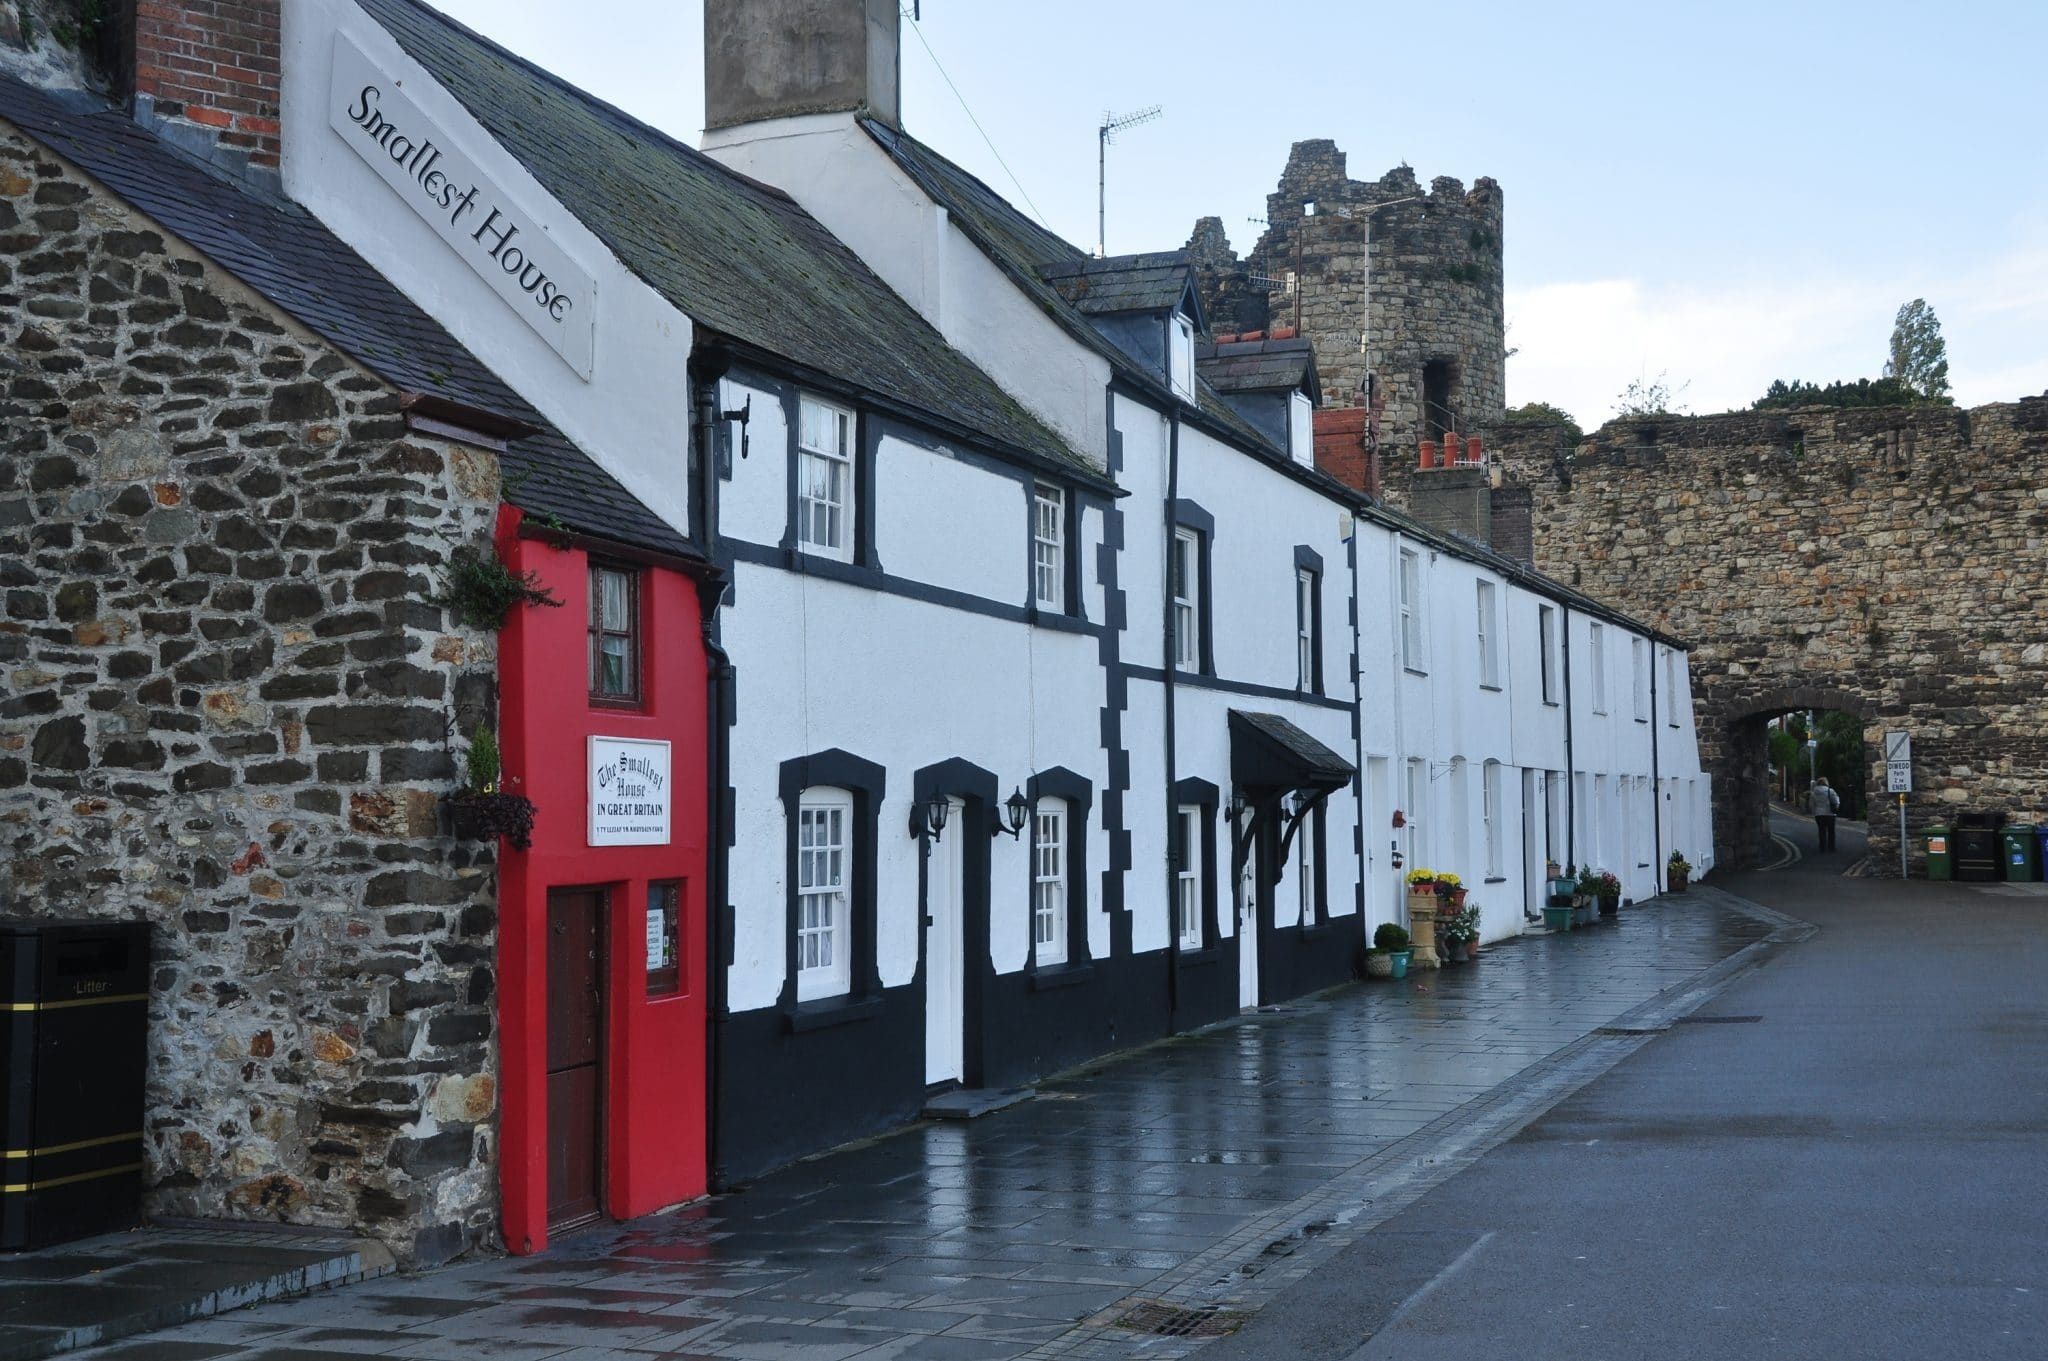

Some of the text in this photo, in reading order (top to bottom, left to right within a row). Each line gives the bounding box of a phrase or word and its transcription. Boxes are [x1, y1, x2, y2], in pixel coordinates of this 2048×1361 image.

[347, 85, 574, 324] Smallest House
[597, 751, 663, 790] The Smallest
[617, 777, 646, 797] House
[597, 803, 663, 816] IN GREAT BRITAIN
[76, 980, 107, 994] Litter
